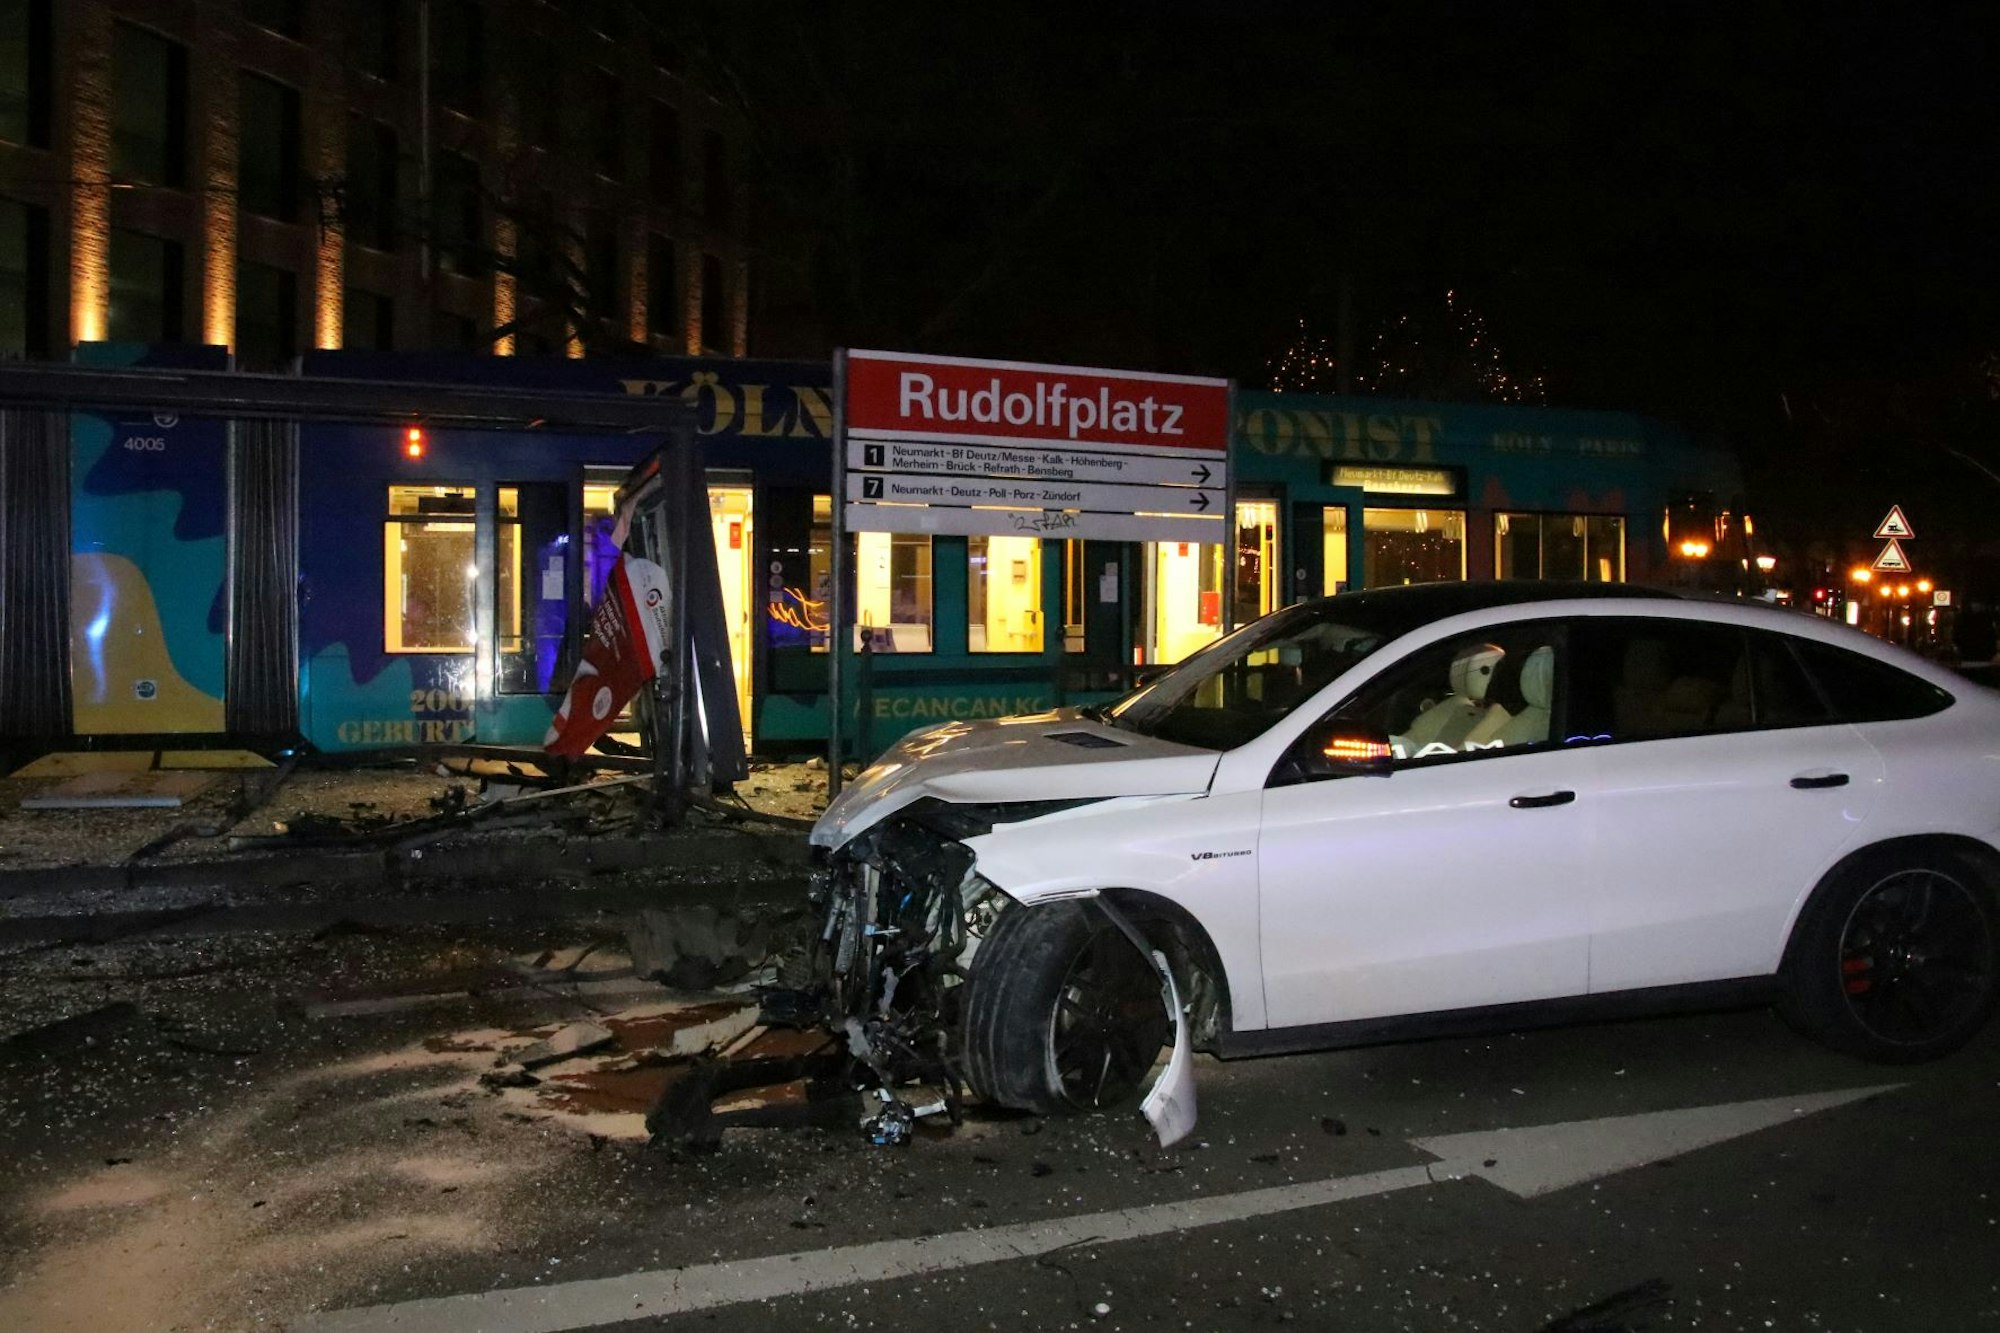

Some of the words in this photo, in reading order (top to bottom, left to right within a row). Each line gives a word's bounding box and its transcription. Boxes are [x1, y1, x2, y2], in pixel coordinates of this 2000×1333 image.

[901, 372, 1184, 439] Rudolfplatz
[123, 437, 166, 451] 4005
[892, 446, 944, 458] Neumarkt
[952, 449, 964, 459] Bf
[892, 458, 939, 470] Merheim
[1027, 465, 1074, 479] Bensberg
[891, 484, 943, 496] Neumarkt
[951, 487, 982, 497] Deutz
[989, 488, 1007, 498] Poll
[1013, 489, 1035, 500] Porz
